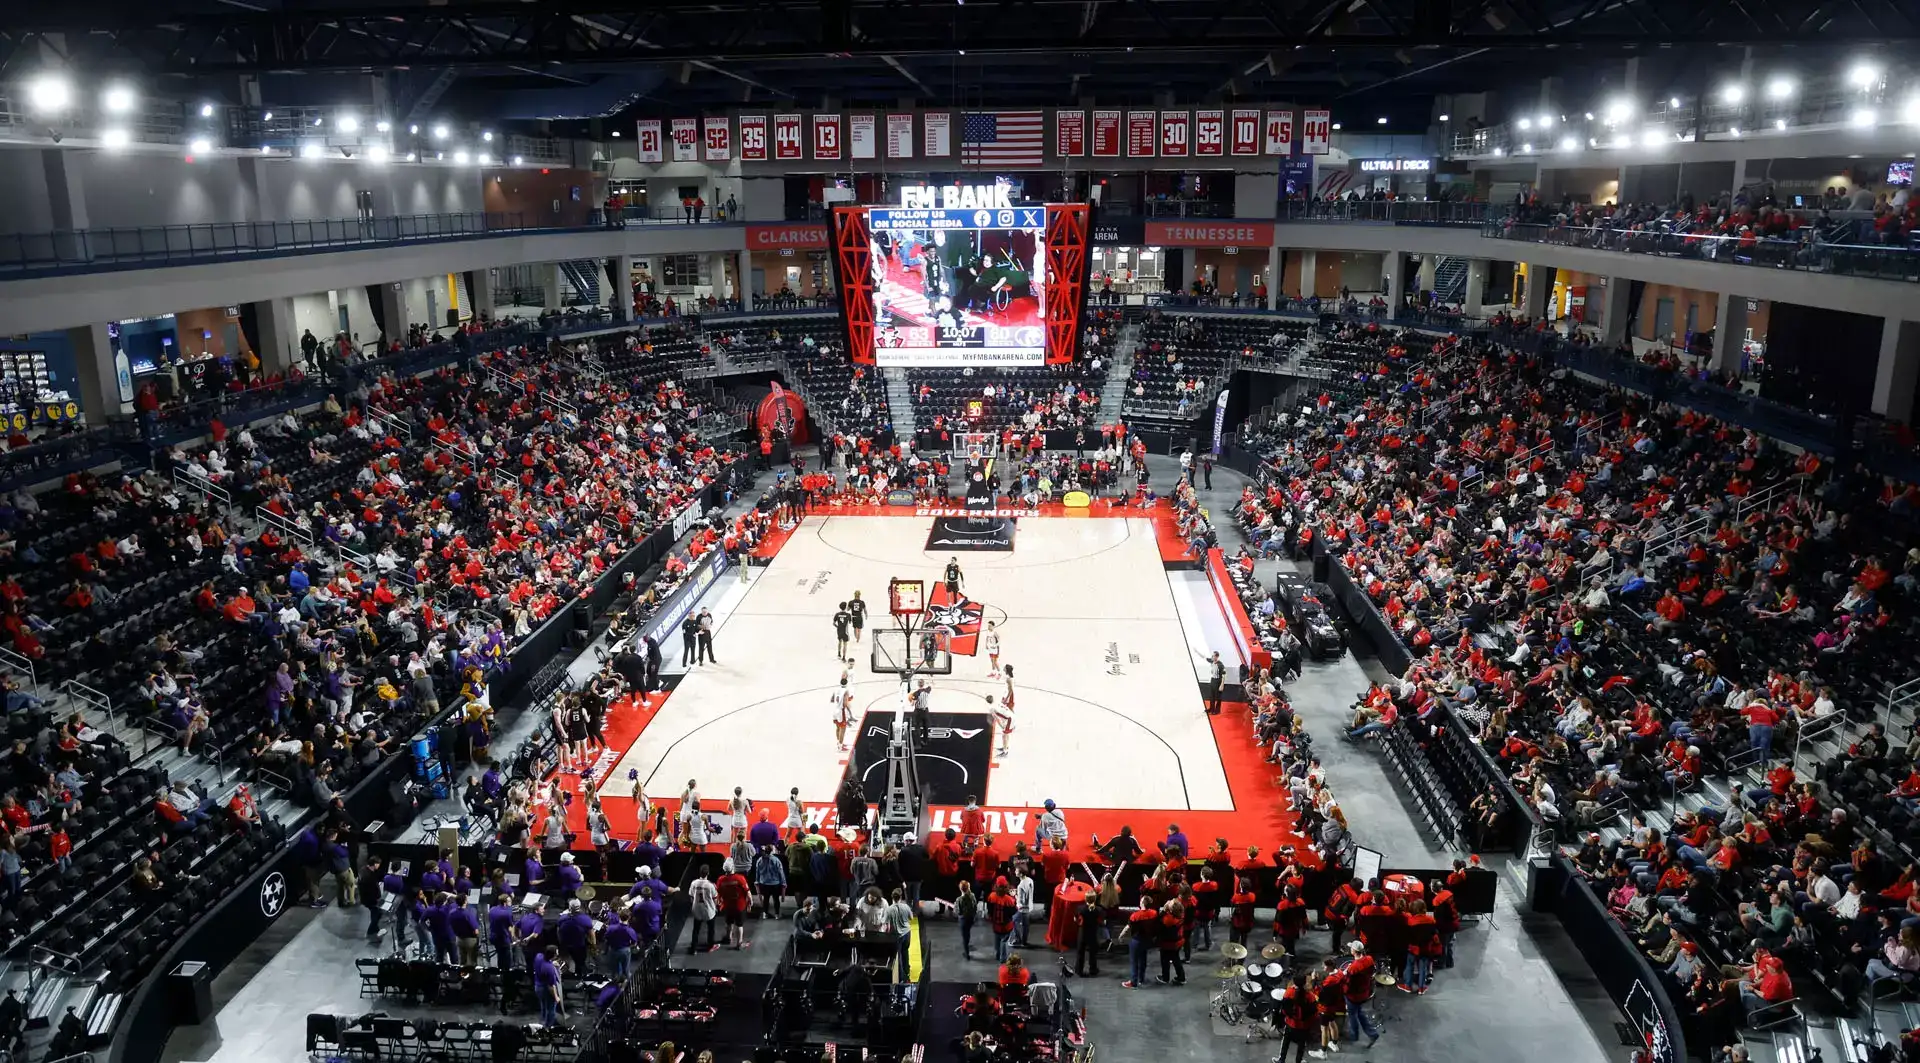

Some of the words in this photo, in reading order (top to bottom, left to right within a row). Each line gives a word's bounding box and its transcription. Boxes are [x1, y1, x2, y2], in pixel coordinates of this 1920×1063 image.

[674, 130, 696, 144] 420
[706, 128, 728, 150] 52
[742, 128, 764, 148] 35
[778, 126, 800, 148] 44
[818, 126, 836, 148] 13
[1164, 123, 1186, 144] 30
[1199, 122, 1220, 144] 52
[1238, 122, 1254, 143] 10
[1268, 122, 1290, 144] 45
[1305, 122, 1328, 142] 44
[642, 130, 658, 152] 21
[1361, 160, 1394, 170] ULTRA
[1402, 160, 1430, 170] DECK
[943, 185, 1013, 208] BANK
[888, 210, 928, 218] FOLLOW
[932, 210, 946, 218] US
[874, 220, 890, 228] ON
[892, 220, 928, 228] SOCIAL
[931, 220, 963, 228] MEDIA
[1094, 232, 1118, 240] ARENA
[1166, 228, 1254, 240] TENNESSEE
[1748, 302, 1757, 310] 106
[942, 327, 976, 338] 10:07
[968, 496, 990, 506] Wendy's
[916, 508, 1040, 518] GOVERNORS
[572, 714, 580, 722] 13
[868, 726, 984, 739] ASN
